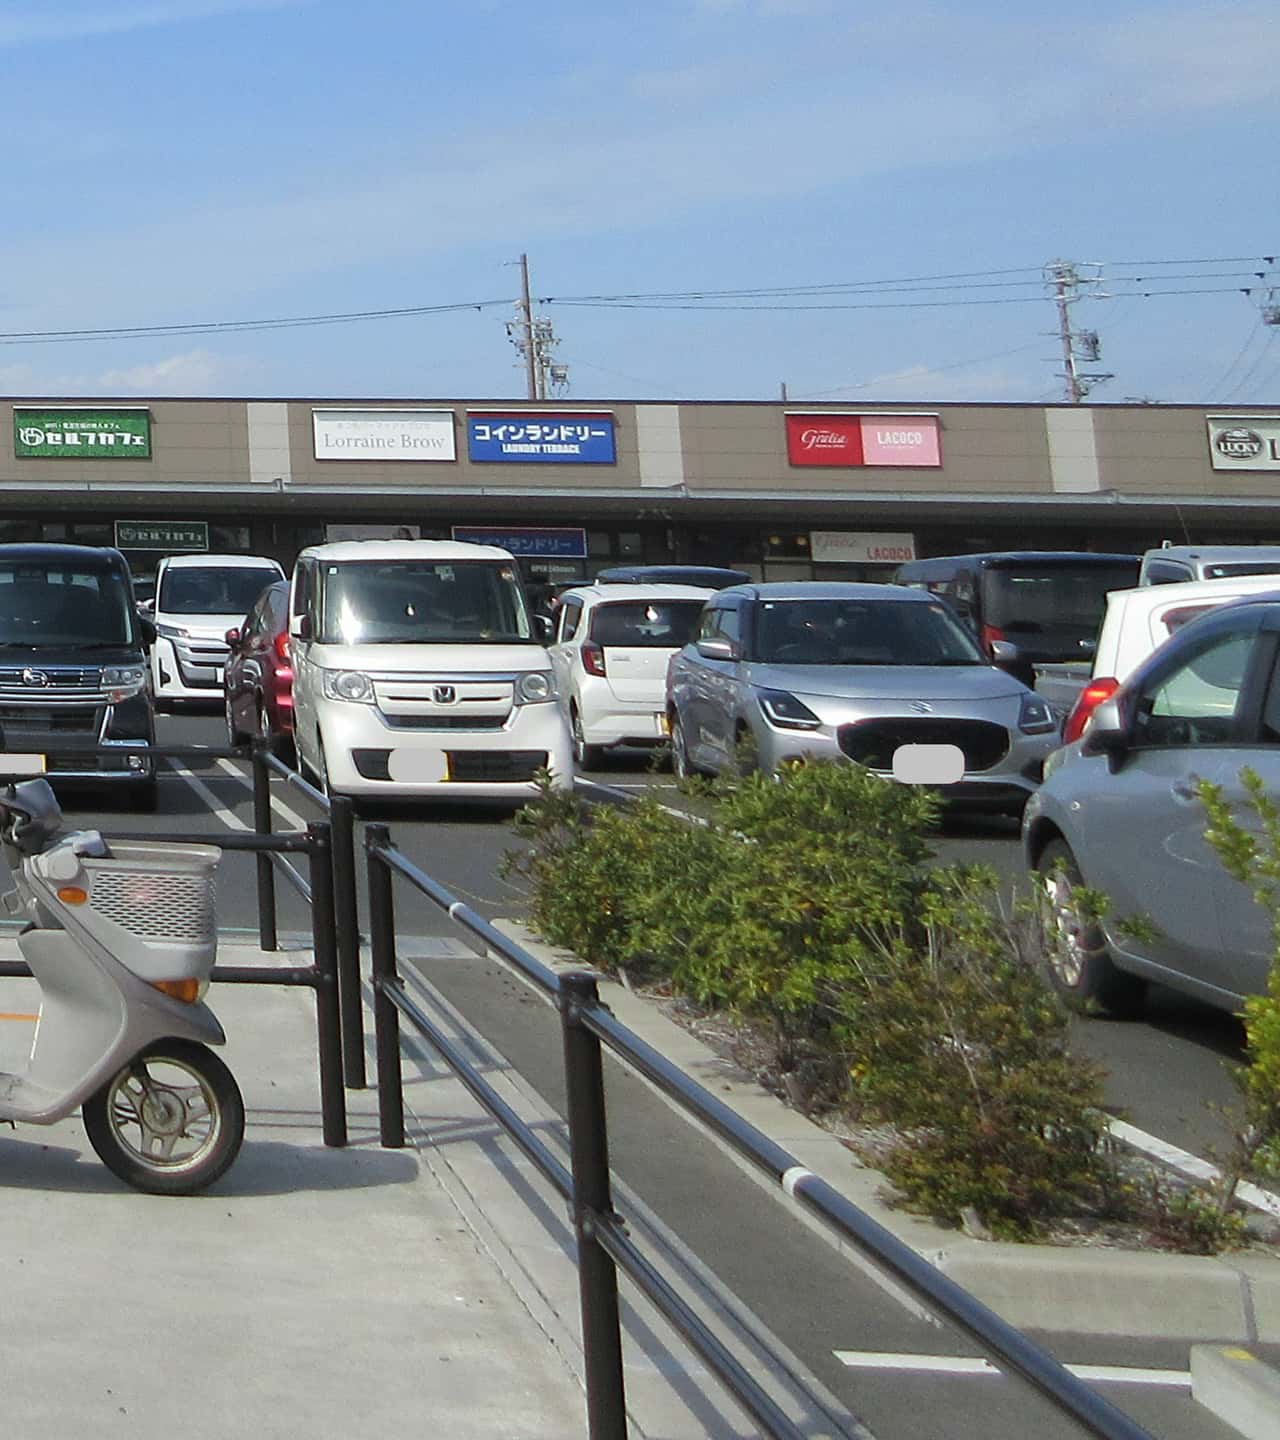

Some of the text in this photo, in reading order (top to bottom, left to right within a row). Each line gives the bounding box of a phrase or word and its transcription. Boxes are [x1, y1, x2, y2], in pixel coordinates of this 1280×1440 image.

[324, 432, 445, 448] Lorraine Brow
[474, 425, 606, 441] コインランドリー
[877, 431, 923, 445] LACOCO
